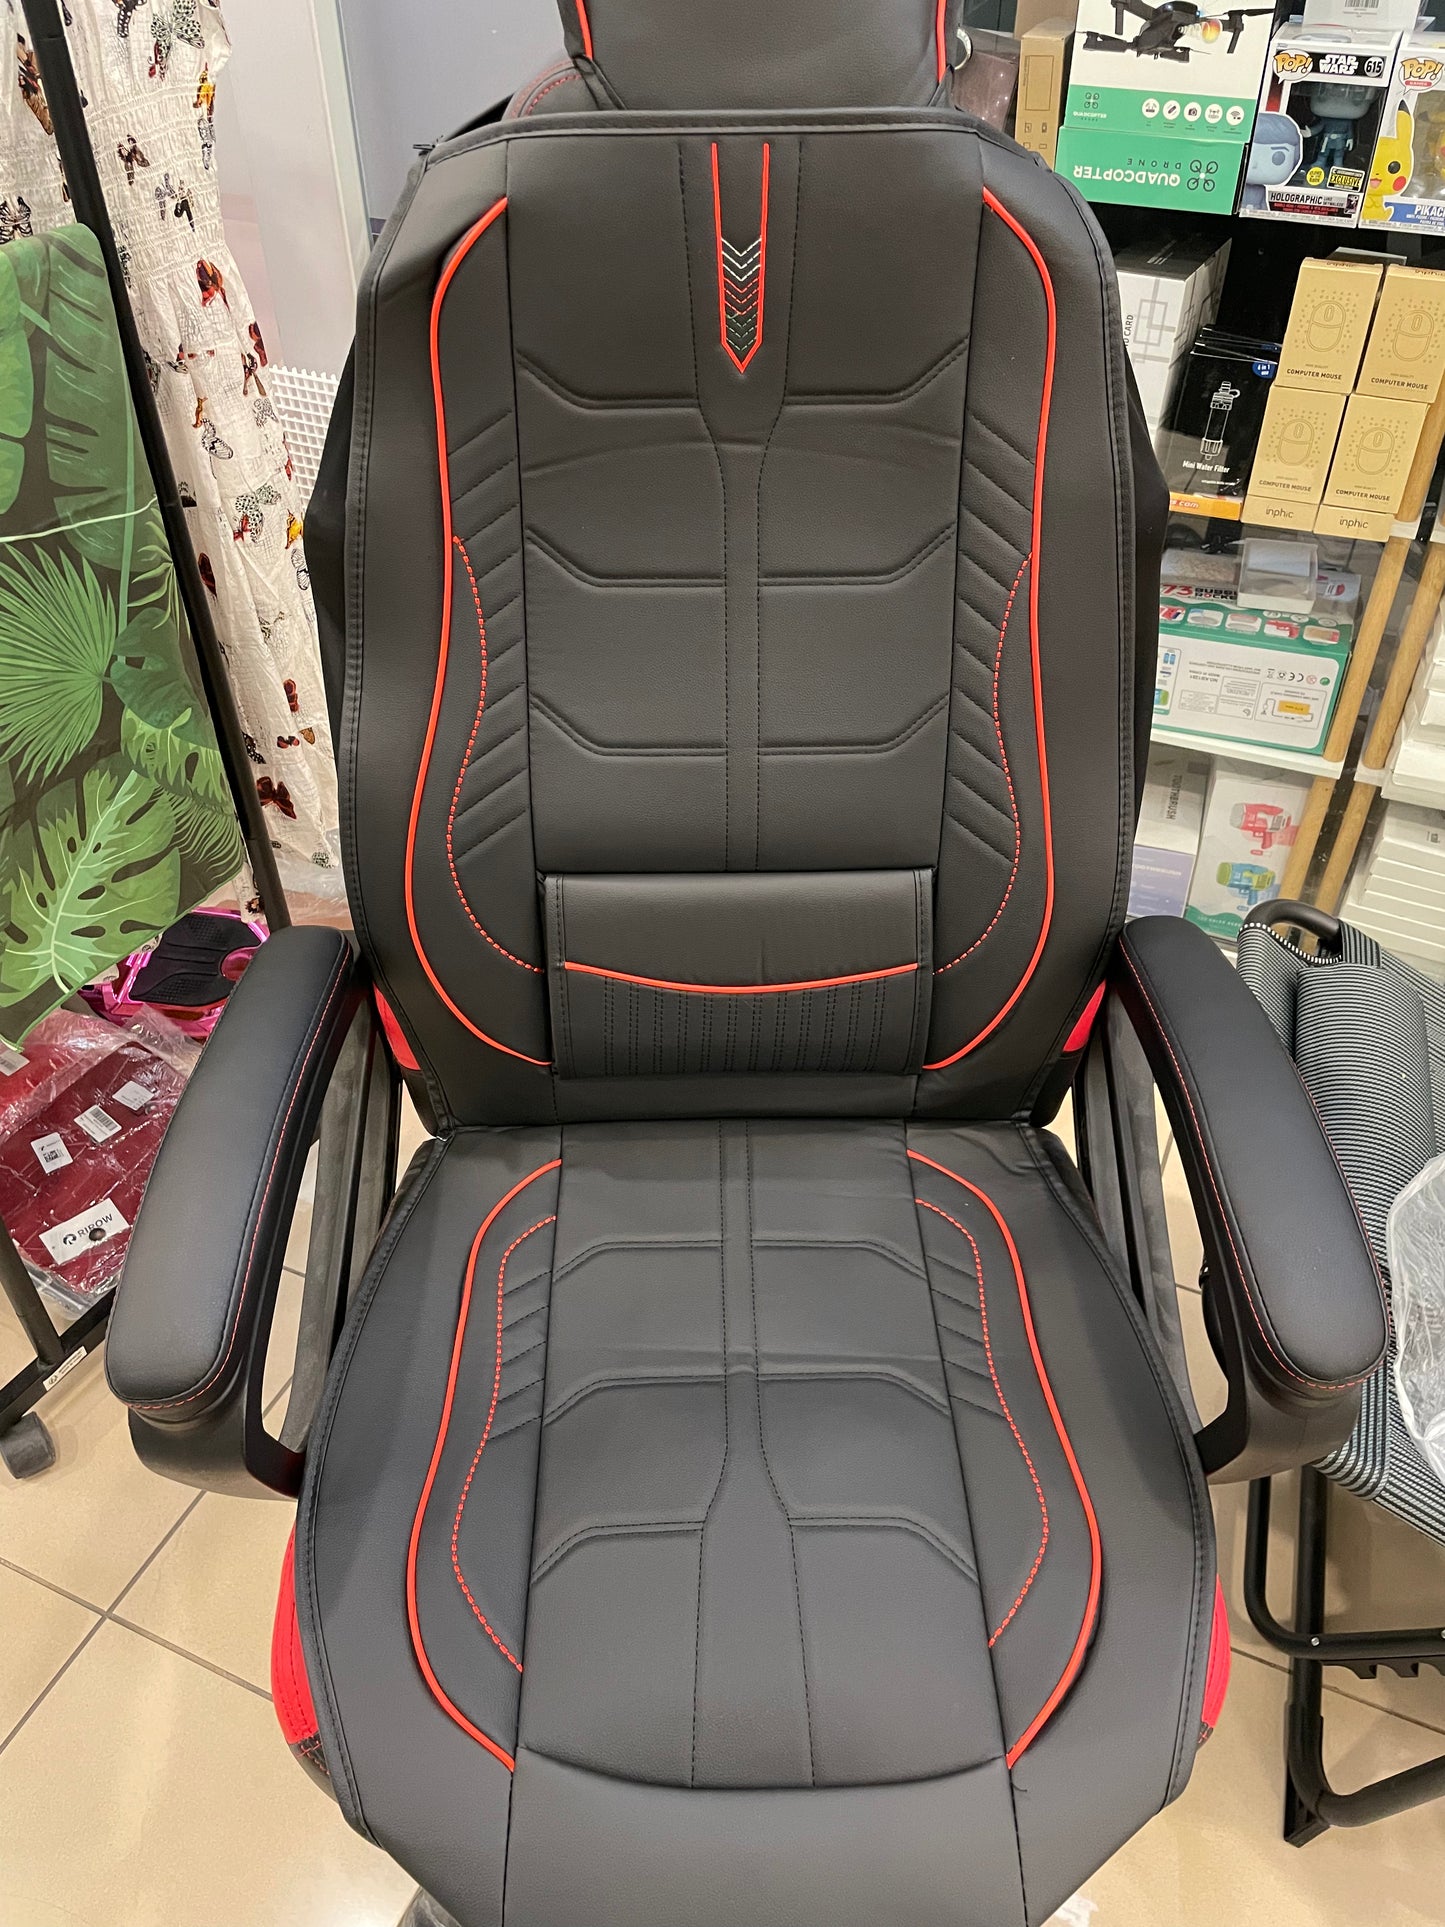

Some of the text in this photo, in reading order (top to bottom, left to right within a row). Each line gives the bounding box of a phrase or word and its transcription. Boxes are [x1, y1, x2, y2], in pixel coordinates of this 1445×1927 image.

[1274, 53, 1312, 73] POP!
[1320, 54, 1358, 67] STAR
[1366, 59, 1382, 73] 615
[1320, 63, 1358, 75] WARS
[1401, 58, 1444, 80] POP!
[1127, 158, 1181, 169] DRONE
[1073, 165, 1181, 187] QUADCOPTER
[1330, 174, 1361, 187] EXCLUSIVE
[1271, 192, 1323, 205] HOLOGRAPHIC
[1124, 315, 1134, 336] CARD
[1287, 368, 1320, 378] COMPUTER
[1371, 377, 1428, 390] COMPUTER MOUSE
[1183, 460, 1231, 473] Mini Water Filter
[1259, 480, 1290, 488] COMPUTER
[1336, 489, 1368, 498] COMPUTER
[1266, 505, 1294, 518] inphic
[1339, 516, 1369, 528] inphic
[1162, 584, 1193, 596] 73
[1166, 774, 1182, 820] TOOTHBRUSH
